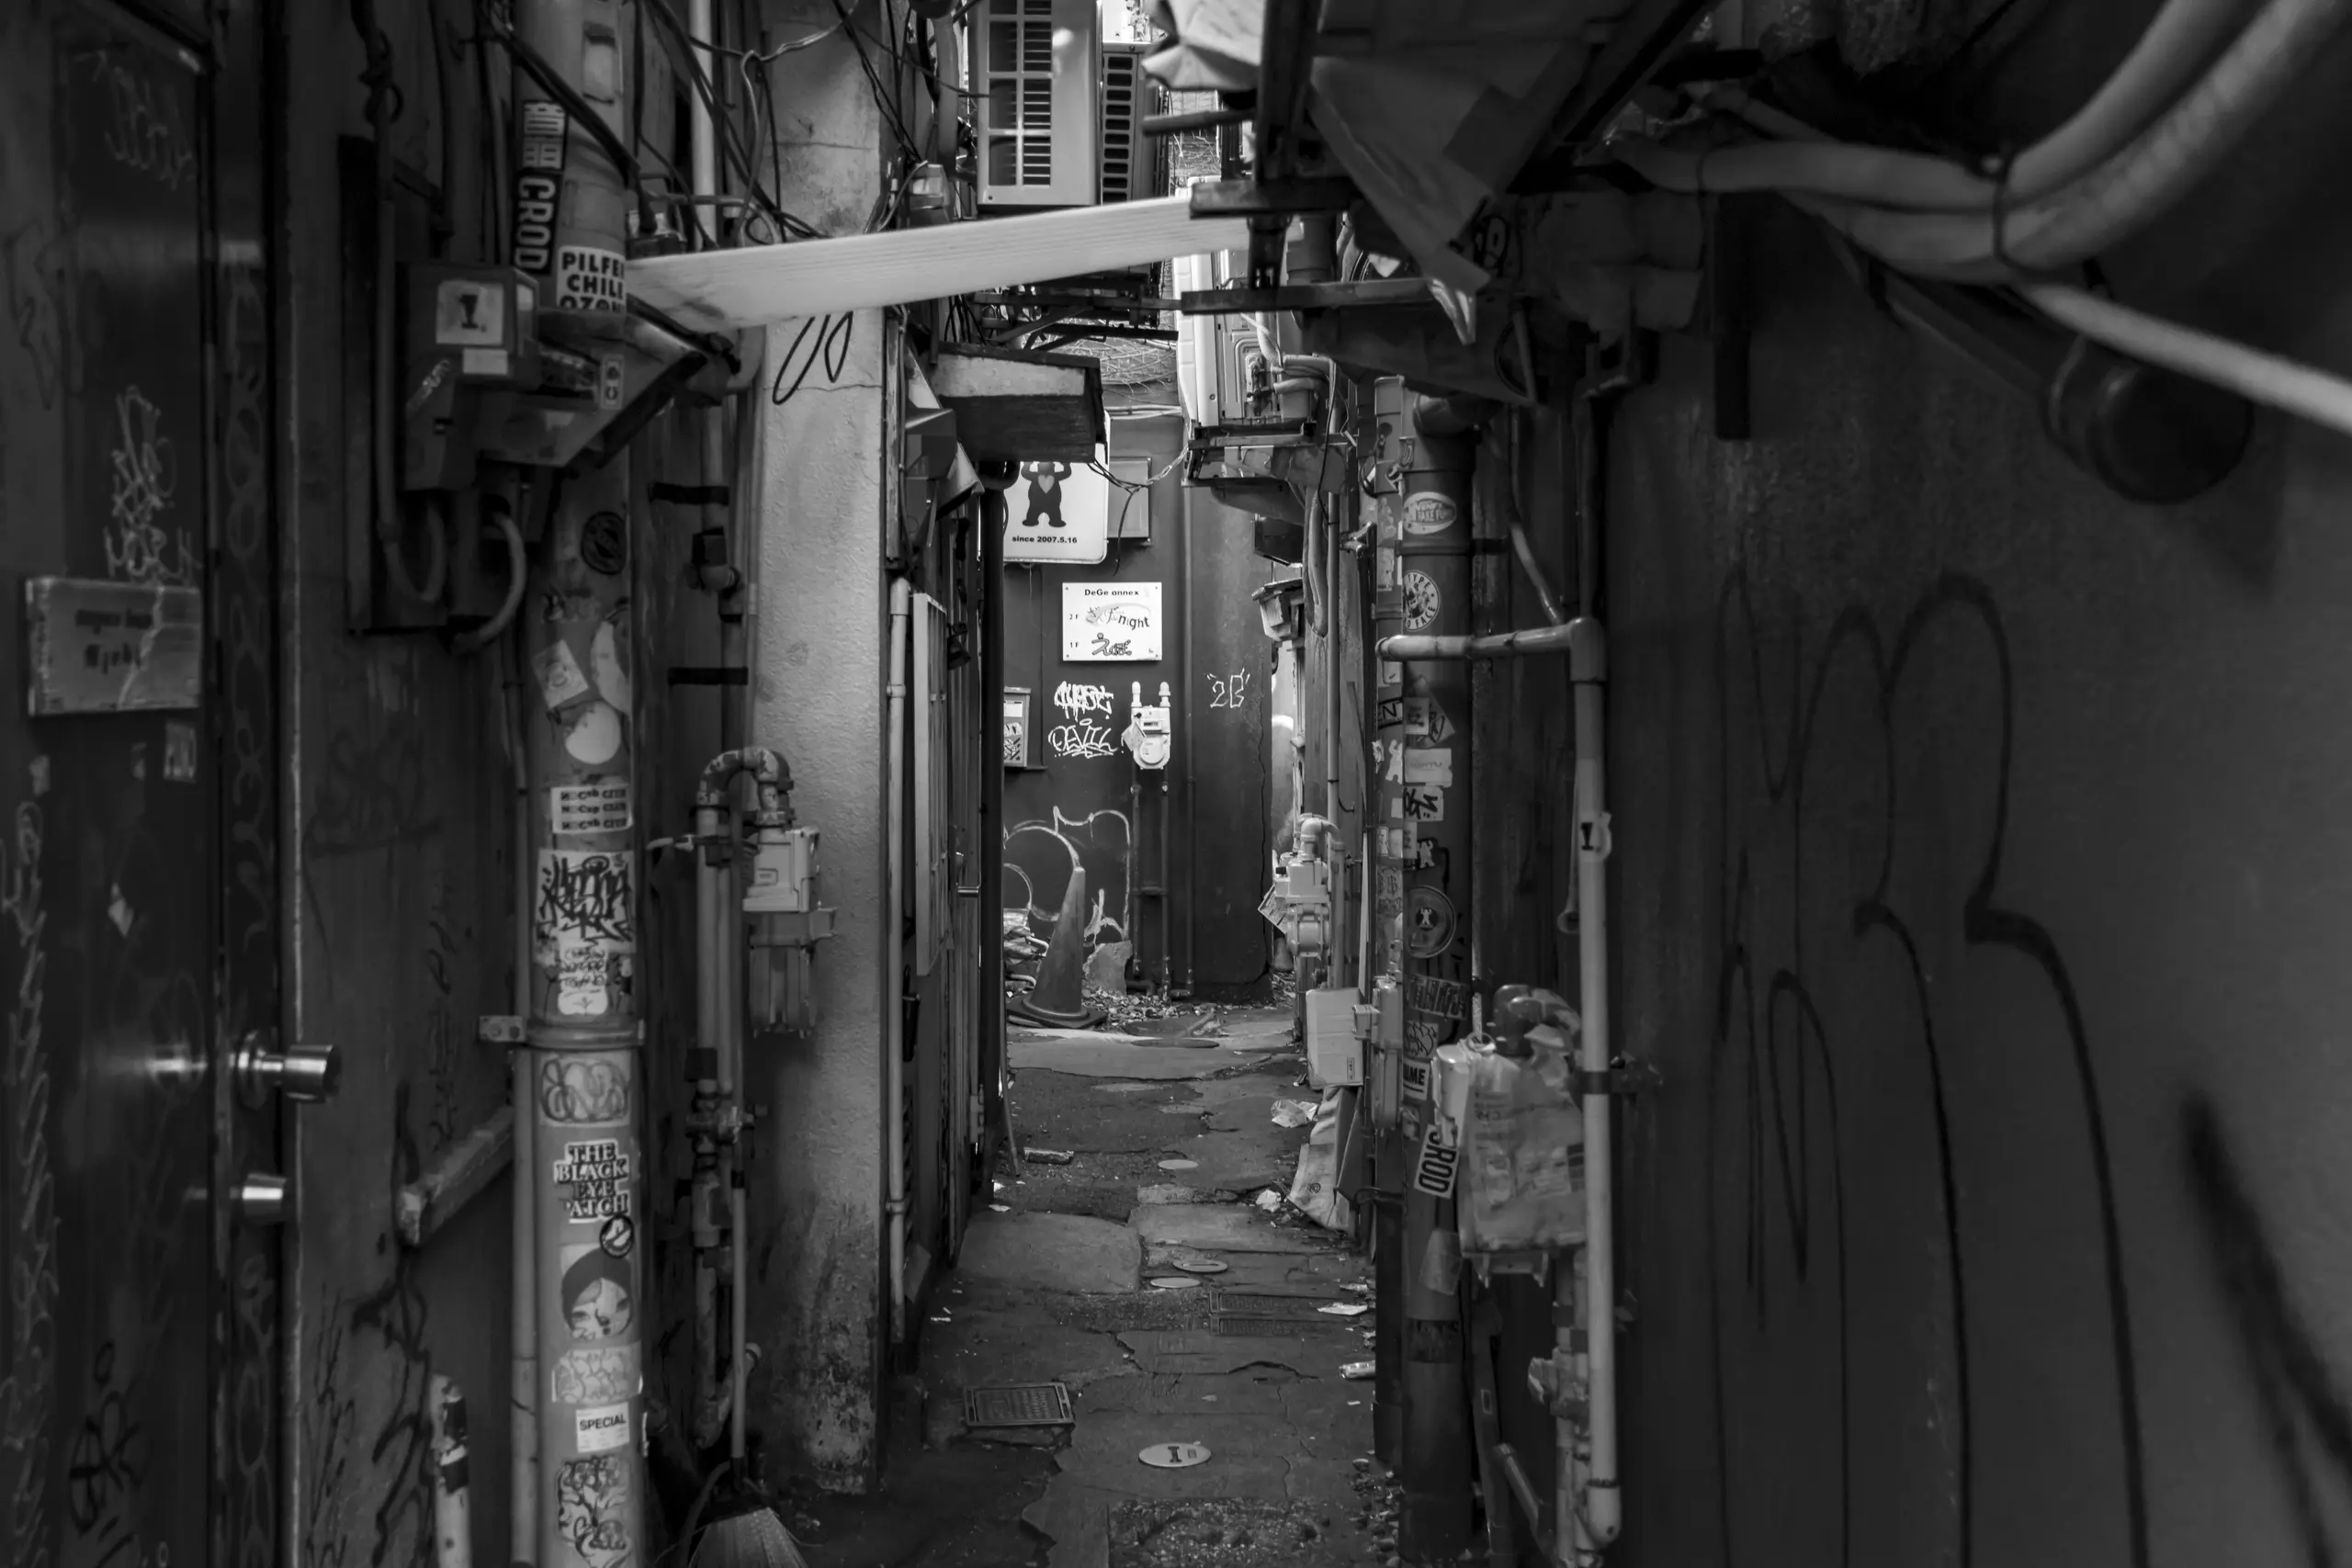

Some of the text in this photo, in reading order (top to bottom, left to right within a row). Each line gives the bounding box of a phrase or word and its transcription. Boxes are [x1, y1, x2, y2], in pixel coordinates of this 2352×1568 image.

[514, 176, 556, 270] CROD
[1012, 535, 1078, 544] since 2007.5.16
[569, 1143, 616, 1163] THE
[557, 1157, 628, 1184] BLACK
[580, 1413, 627, 1431] SPECIAL
